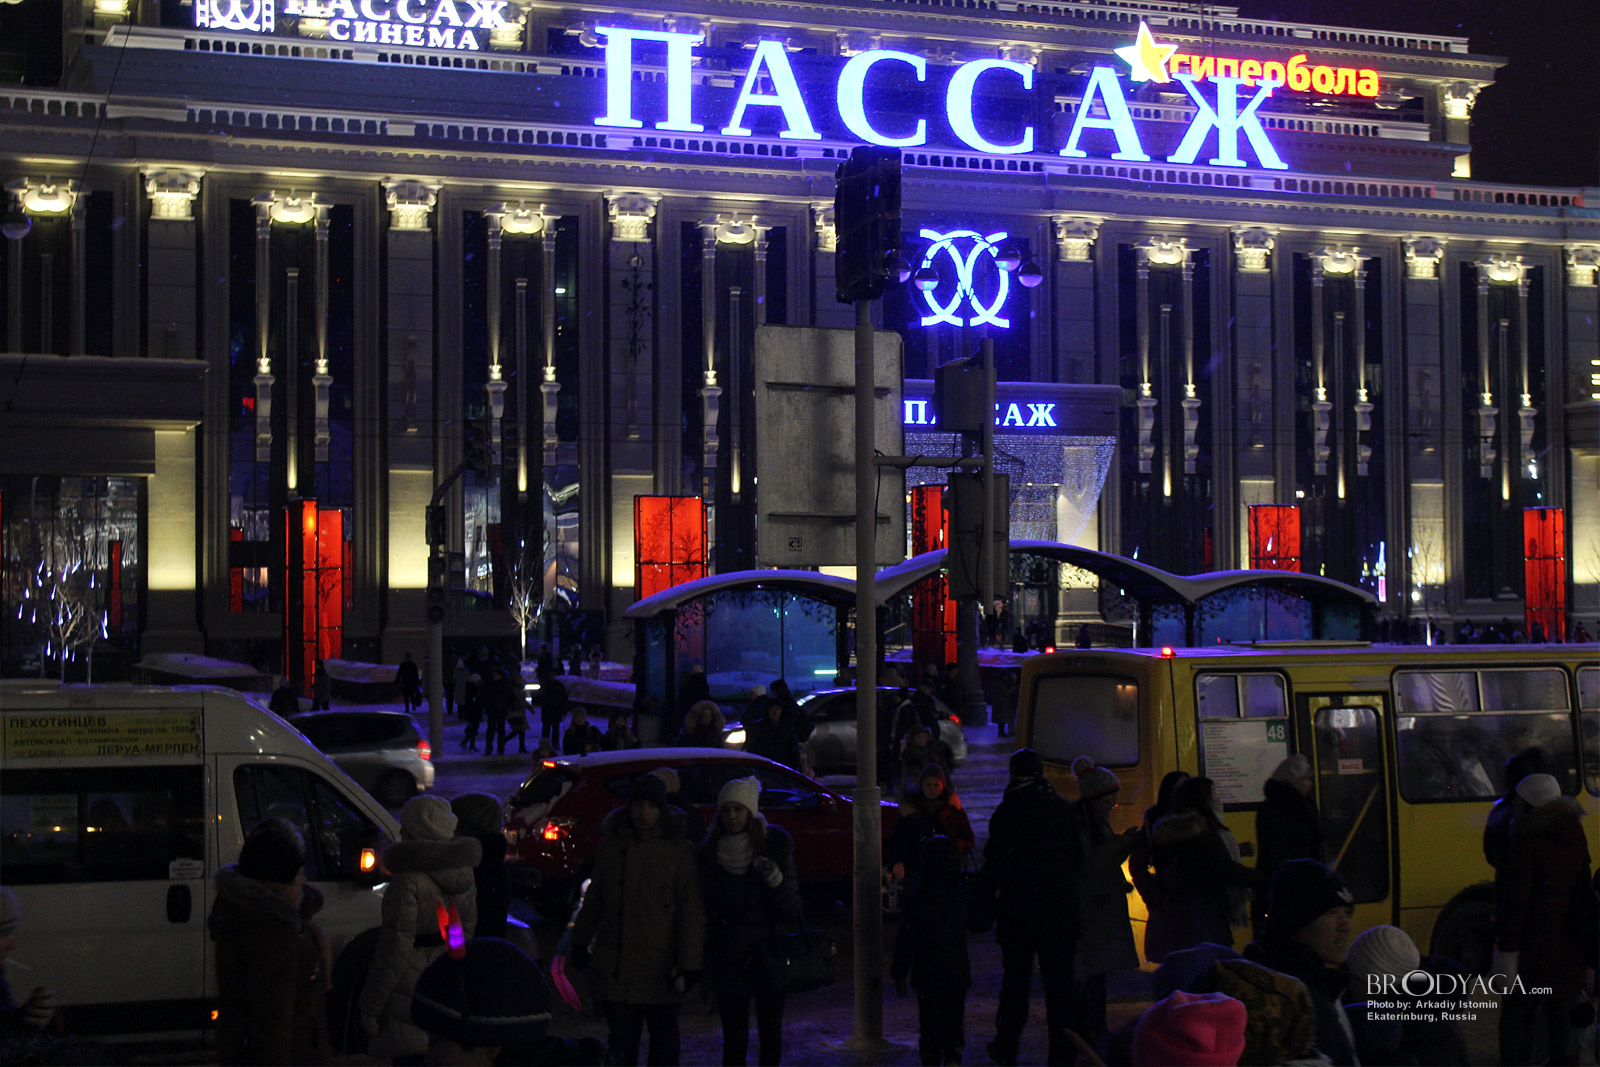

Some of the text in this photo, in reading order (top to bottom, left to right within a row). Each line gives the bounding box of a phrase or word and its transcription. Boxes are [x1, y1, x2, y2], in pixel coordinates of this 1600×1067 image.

[330, 18, 480, 51] СИНЕМА
[1170, 53, 1380, 98] гипербола
[593, 25, 1289, 171] ПАССАЖ
[903, 400, 1058, 427] ПАЖ
[10, 716, 107, 728] ПЕХОТИНЦЕВ
[1267, 724, 1285, 740] 48
